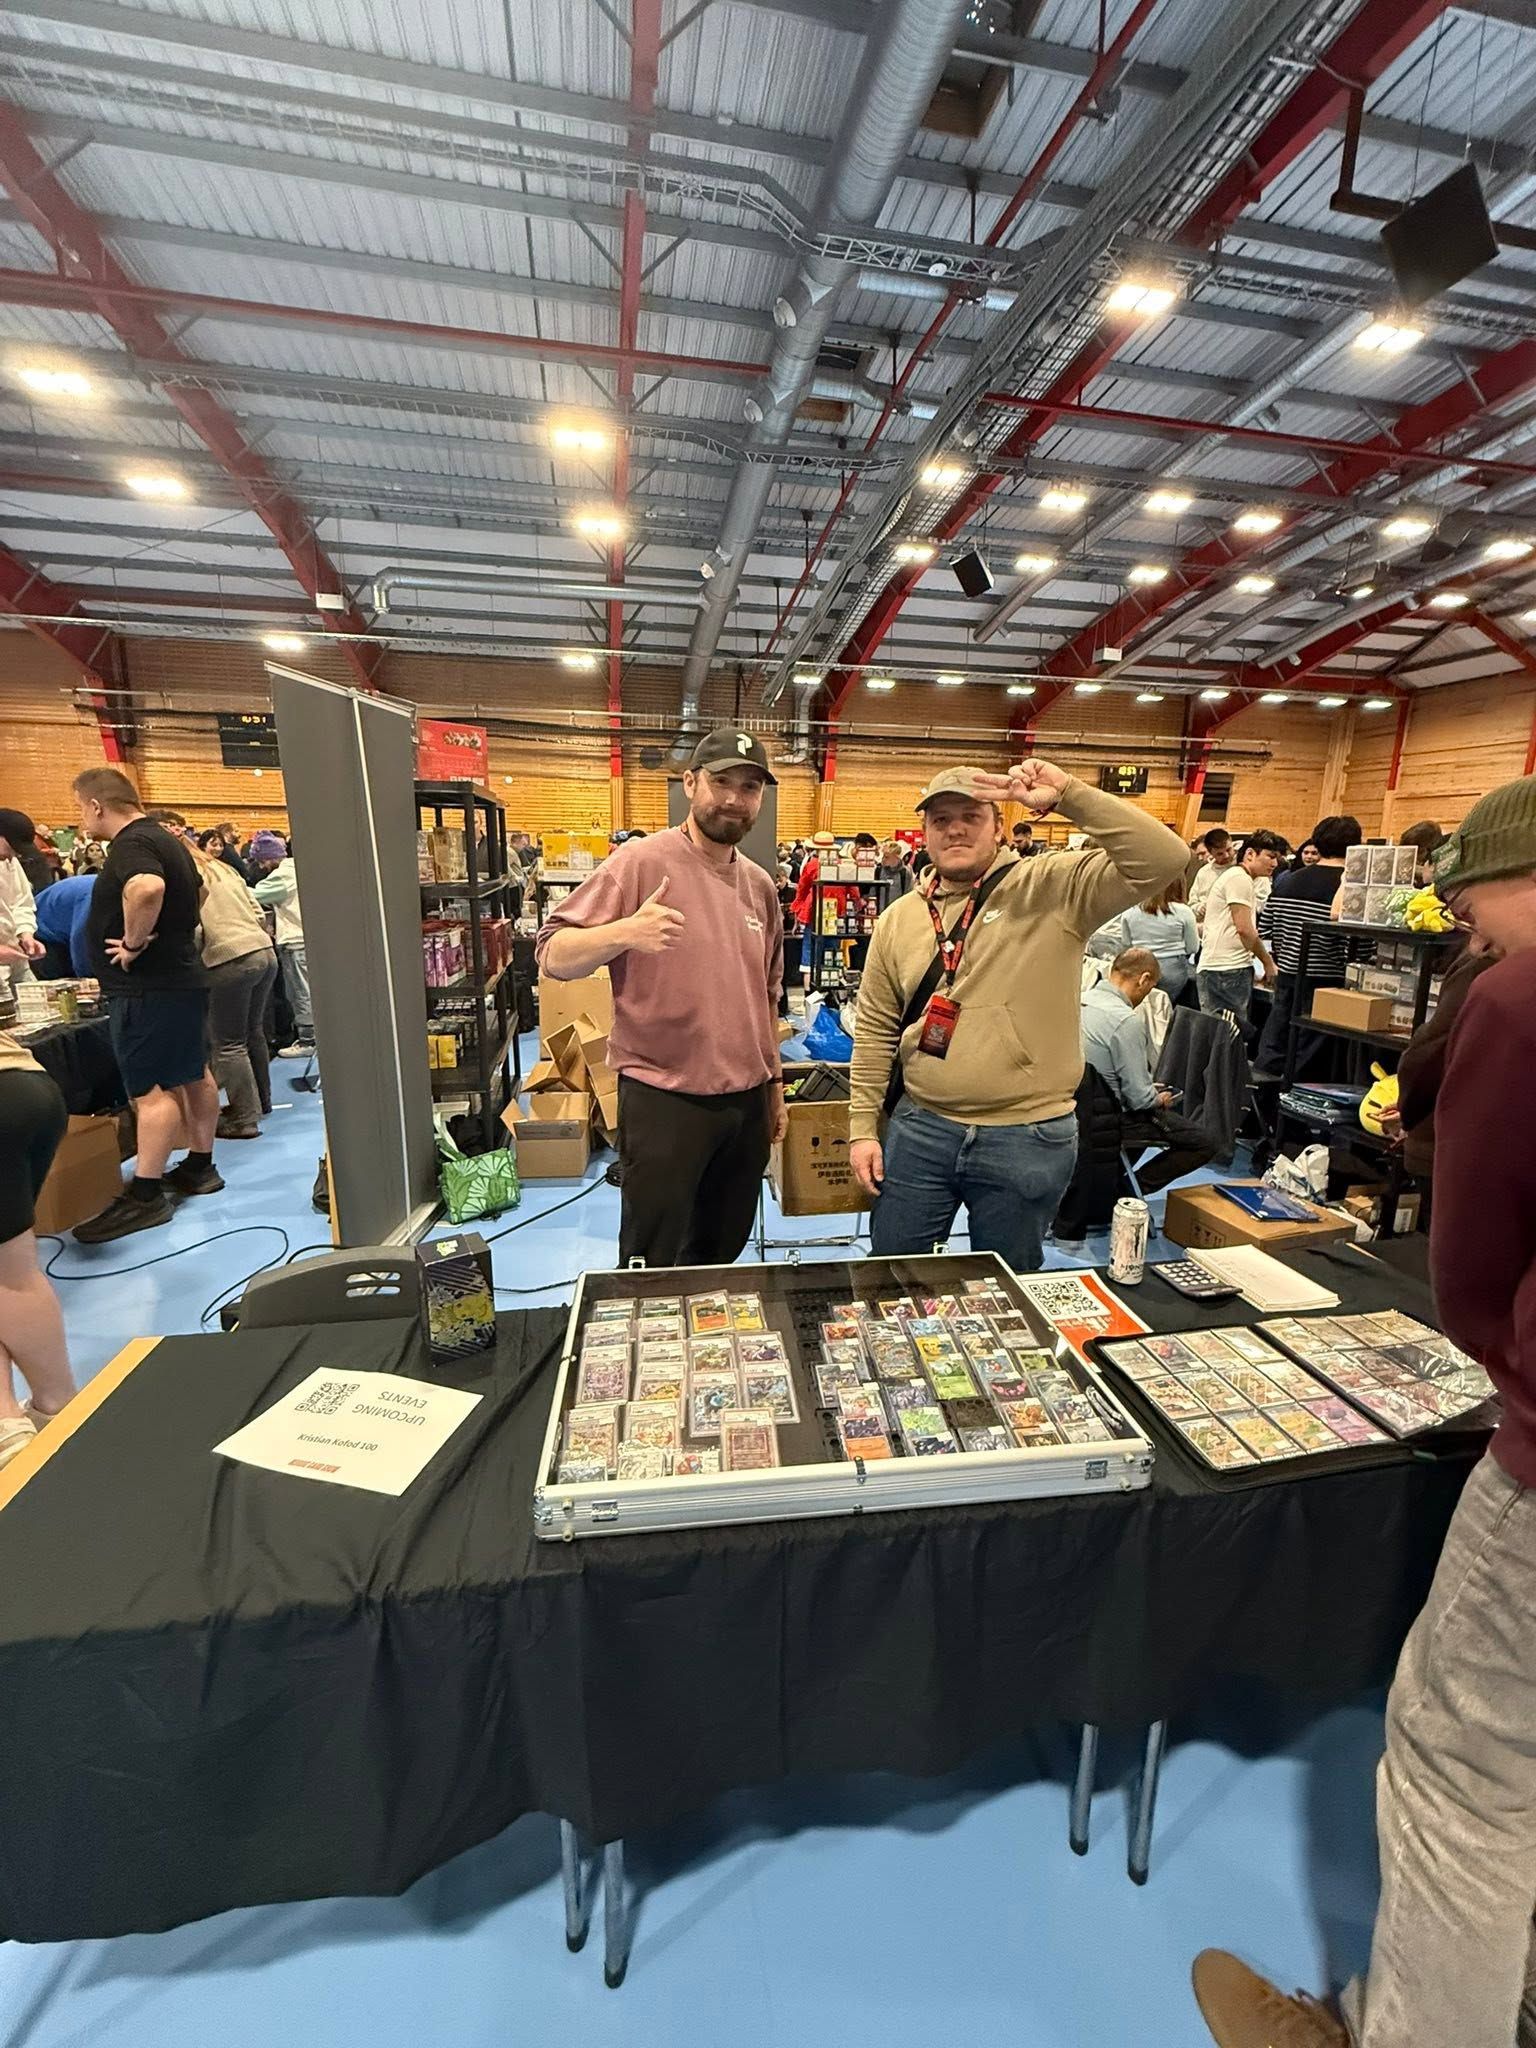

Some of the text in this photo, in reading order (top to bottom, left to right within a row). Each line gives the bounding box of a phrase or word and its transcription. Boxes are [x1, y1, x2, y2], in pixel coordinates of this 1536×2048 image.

[378, 1391, 428, 1409] EVENTS
[352, 1403, 426, 1426] UPCOMING
[297, 1433, 379, 1452] Kristian Kofod 100
